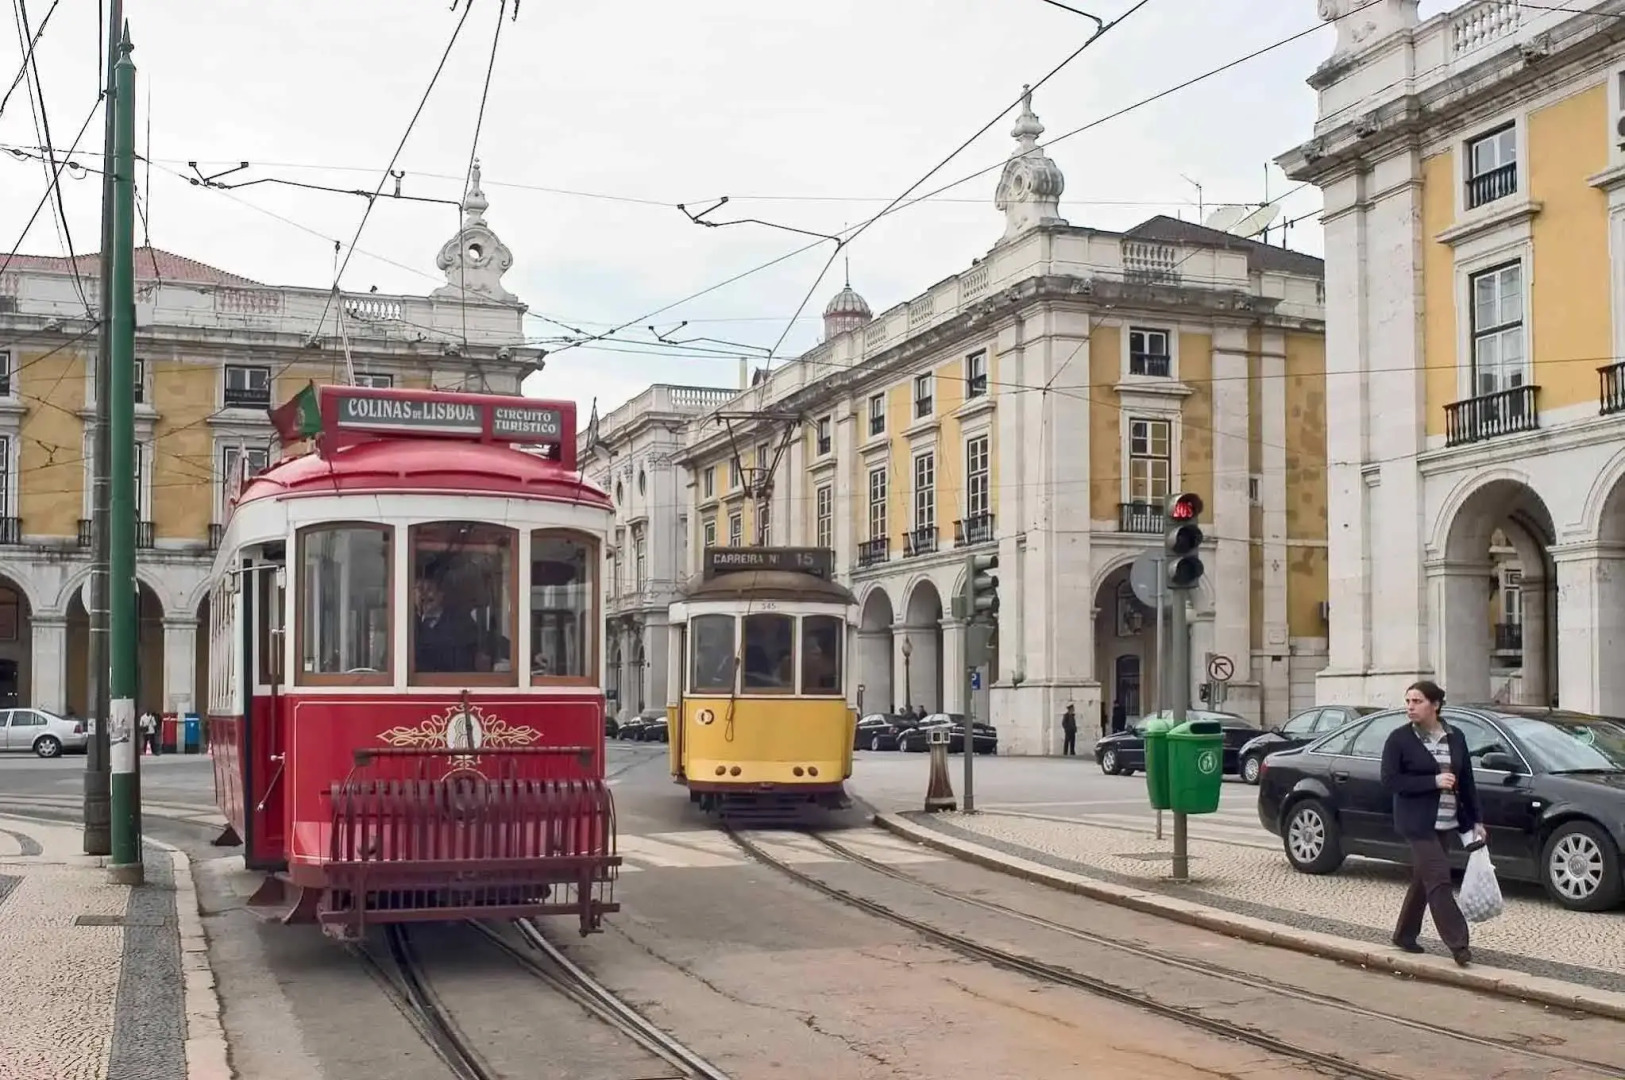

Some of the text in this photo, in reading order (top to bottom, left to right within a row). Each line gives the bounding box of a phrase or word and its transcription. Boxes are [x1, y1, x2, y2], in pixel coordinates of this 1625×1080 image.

[348, 398, 411, 418] COLINAS
[423, 402, 475, 420] LISBOA
[496, 408, 551, 422] CIRCUITO
[714, 554, 763, 564] CARREIRA
[796, 552, 814, 566] 15
